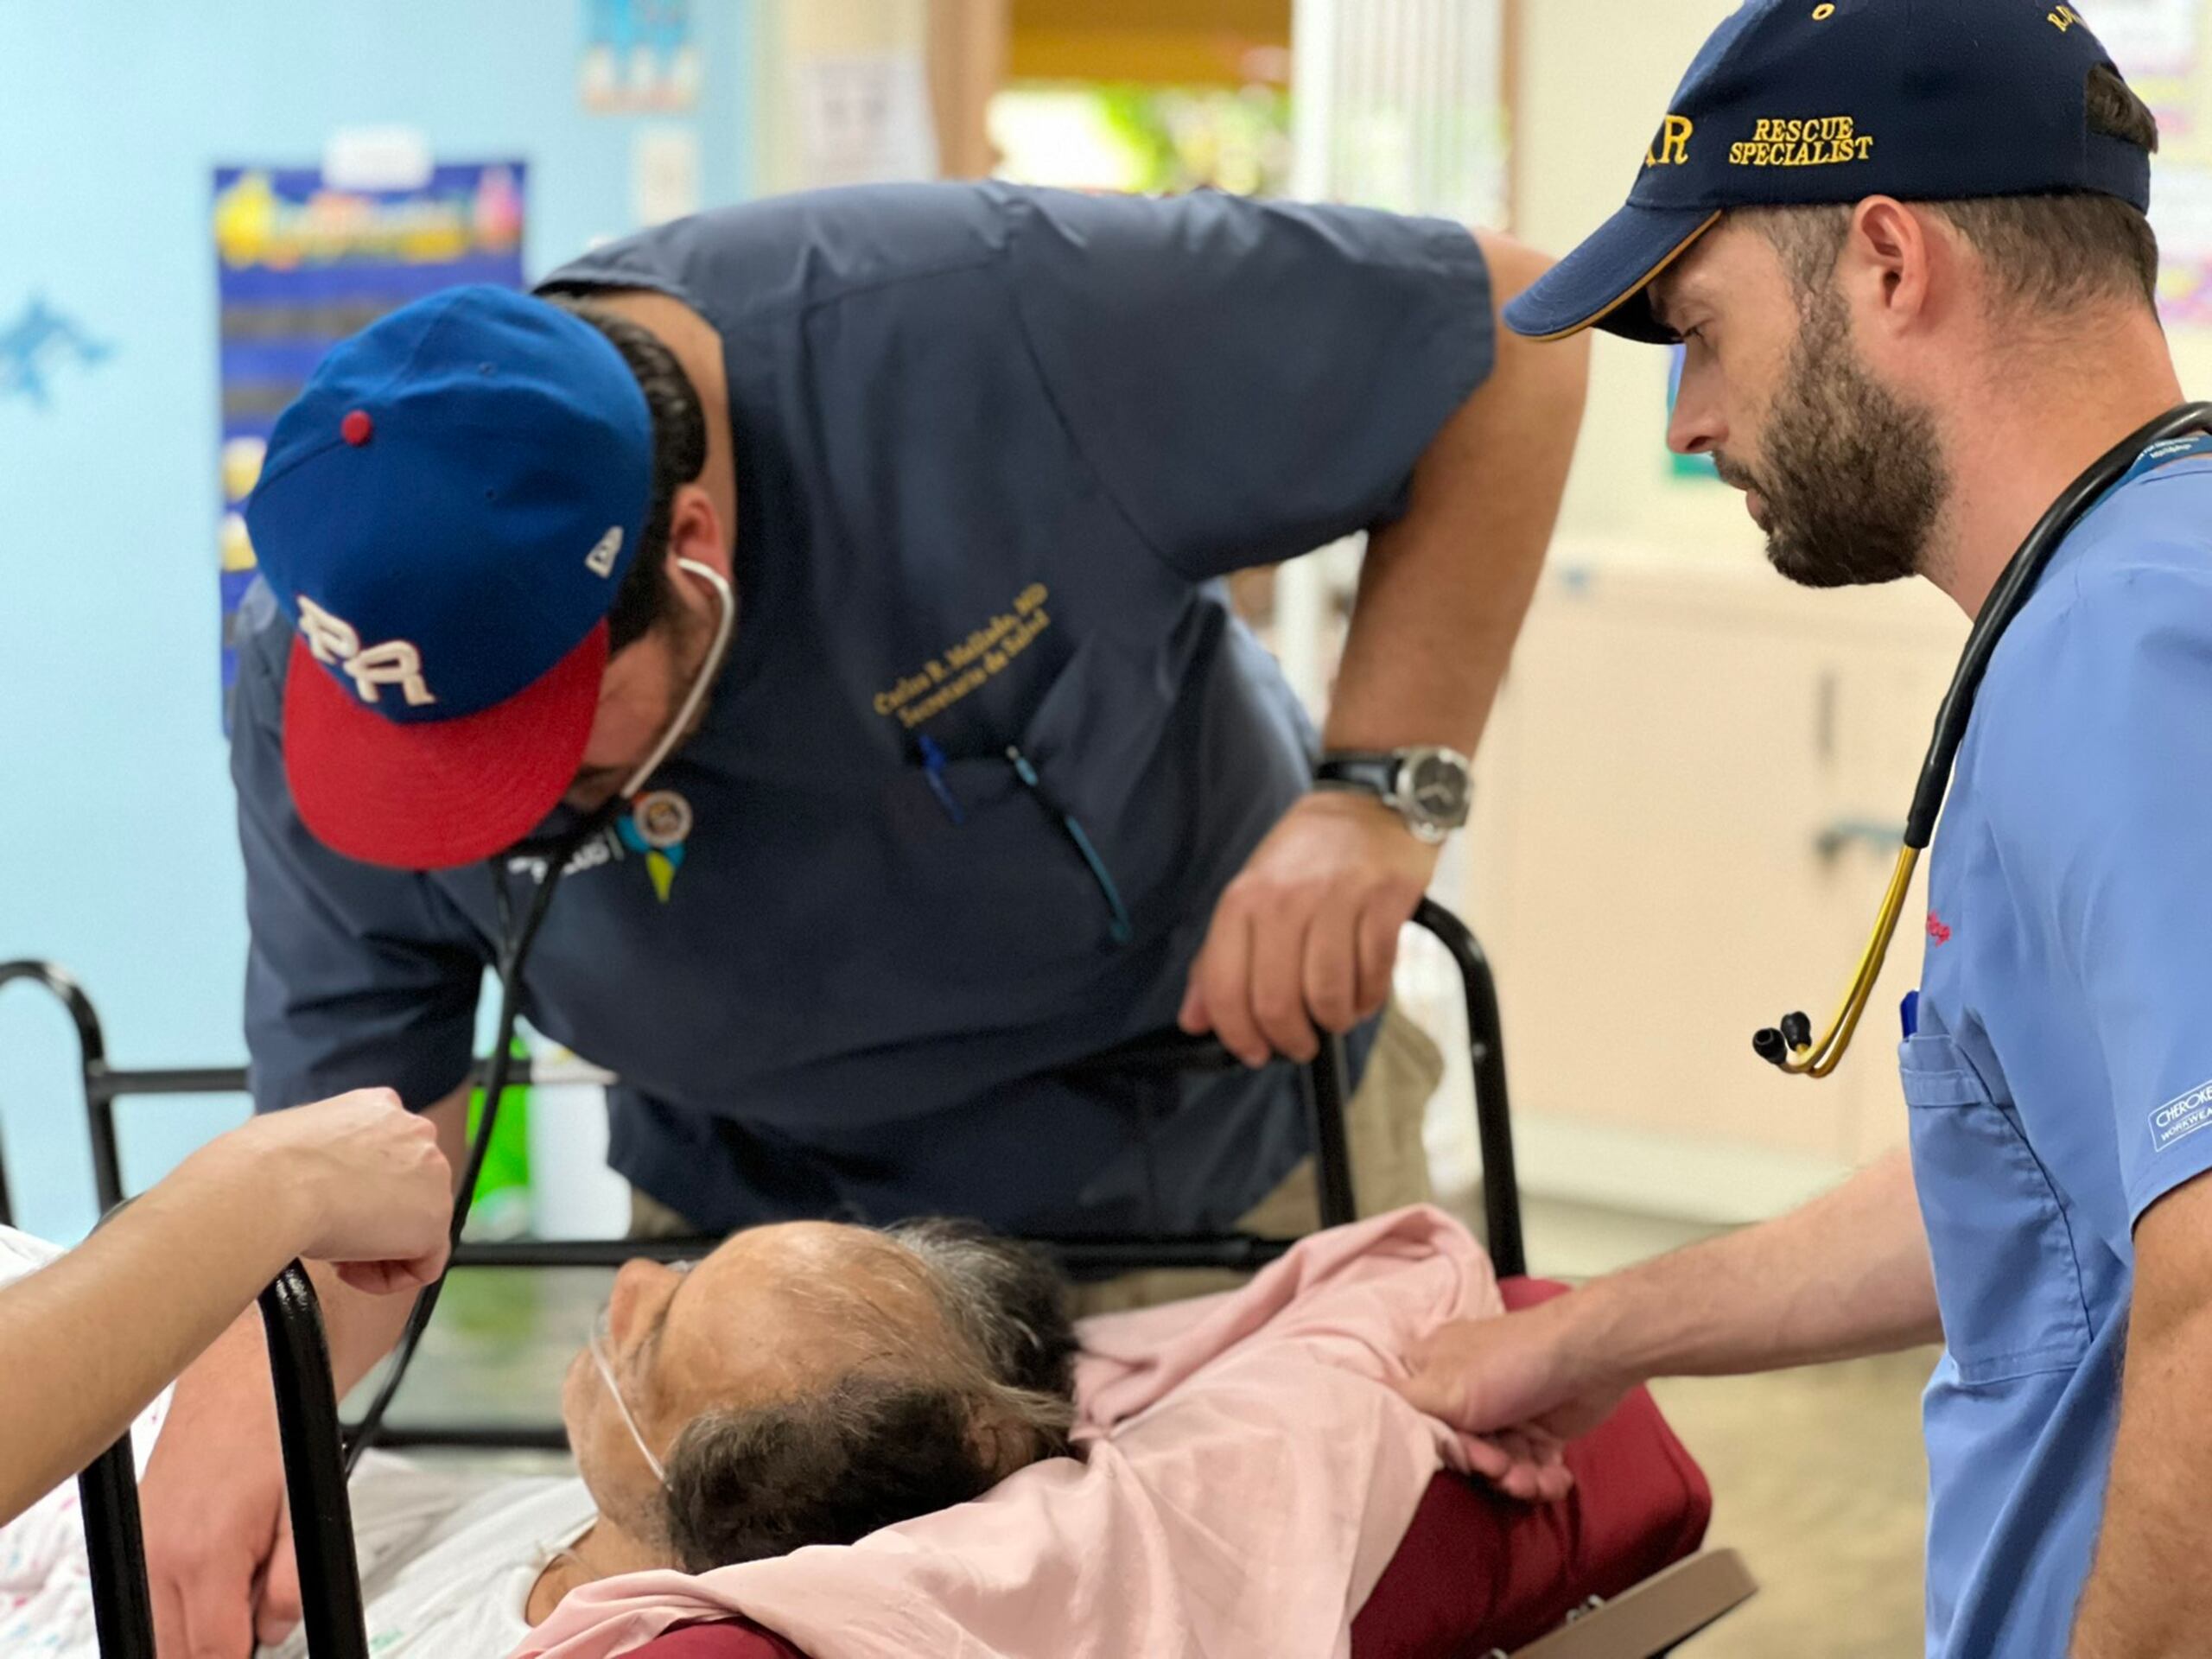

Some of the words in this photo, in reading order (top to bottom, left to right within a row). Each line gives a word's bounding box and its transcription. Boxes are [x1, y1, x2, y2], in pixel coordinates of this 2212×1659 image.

[1752, 116, 1854, 143] RESCUE
[1728, 136, 1874, 167] SPECIALIST
[296, 594, 438, 706] PR
[982, 650, 1009, 674] de
